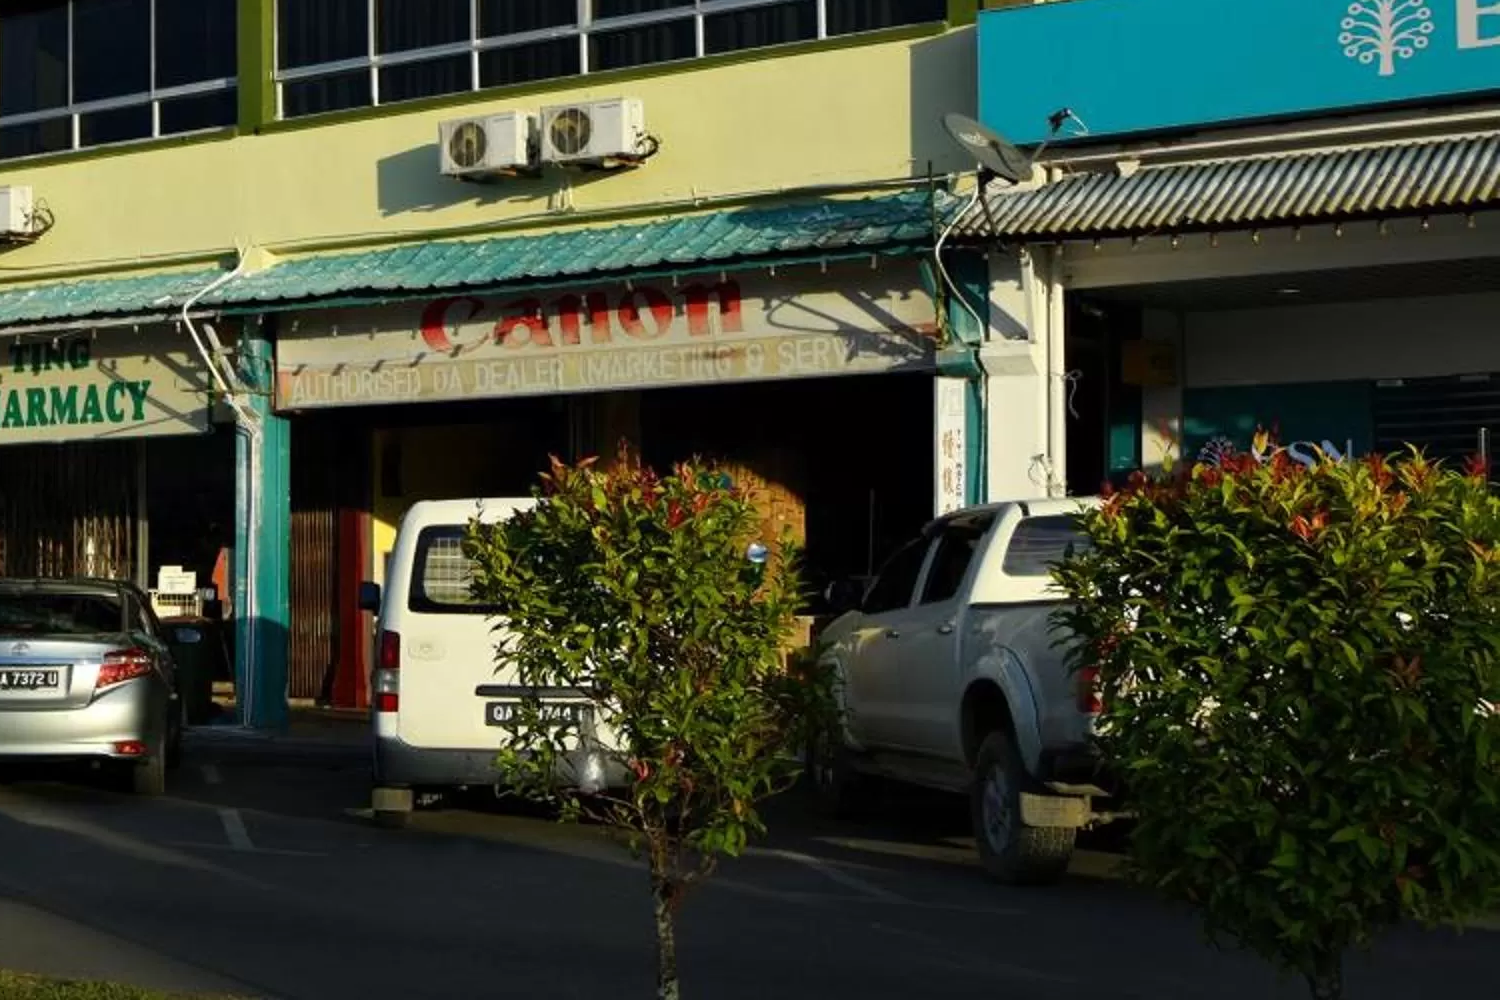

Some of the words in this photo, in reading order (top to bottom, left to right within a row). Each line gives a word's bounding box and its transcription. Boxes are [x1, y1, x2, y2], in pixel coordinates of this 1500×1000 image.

[420, 280, 743, 355] Canon
[9, 338, 91, 373] TING
[291, 367, 422, 402] AUTHORISED
[476, 359, 564, 392] DEALER
[12, 672, 45, 685] 7372
